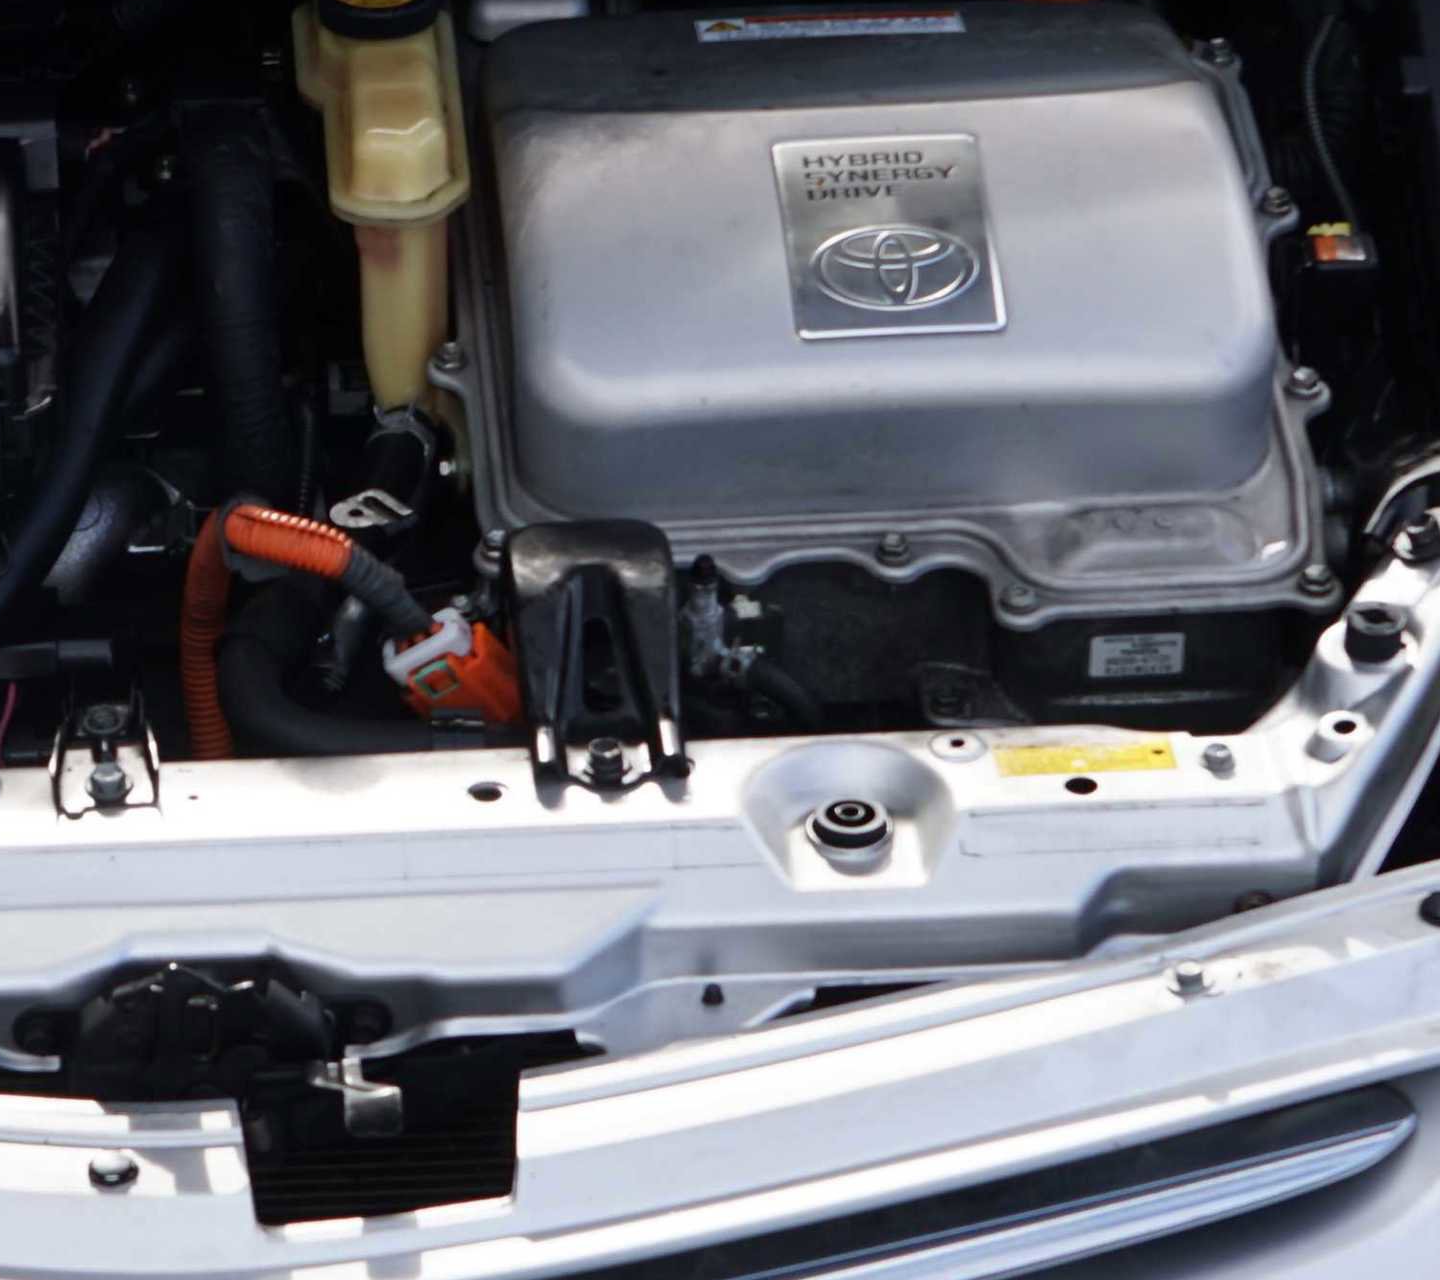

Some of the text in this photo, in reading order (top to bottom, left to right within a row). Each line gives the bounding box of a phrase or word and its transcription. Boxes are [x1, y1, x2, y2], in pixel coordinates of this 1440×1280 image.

[802, 152, 923, 169] HYBRID
[805, 165, 953, 186] SYNERGY
[807, 185, 902, 201] DRIVE
